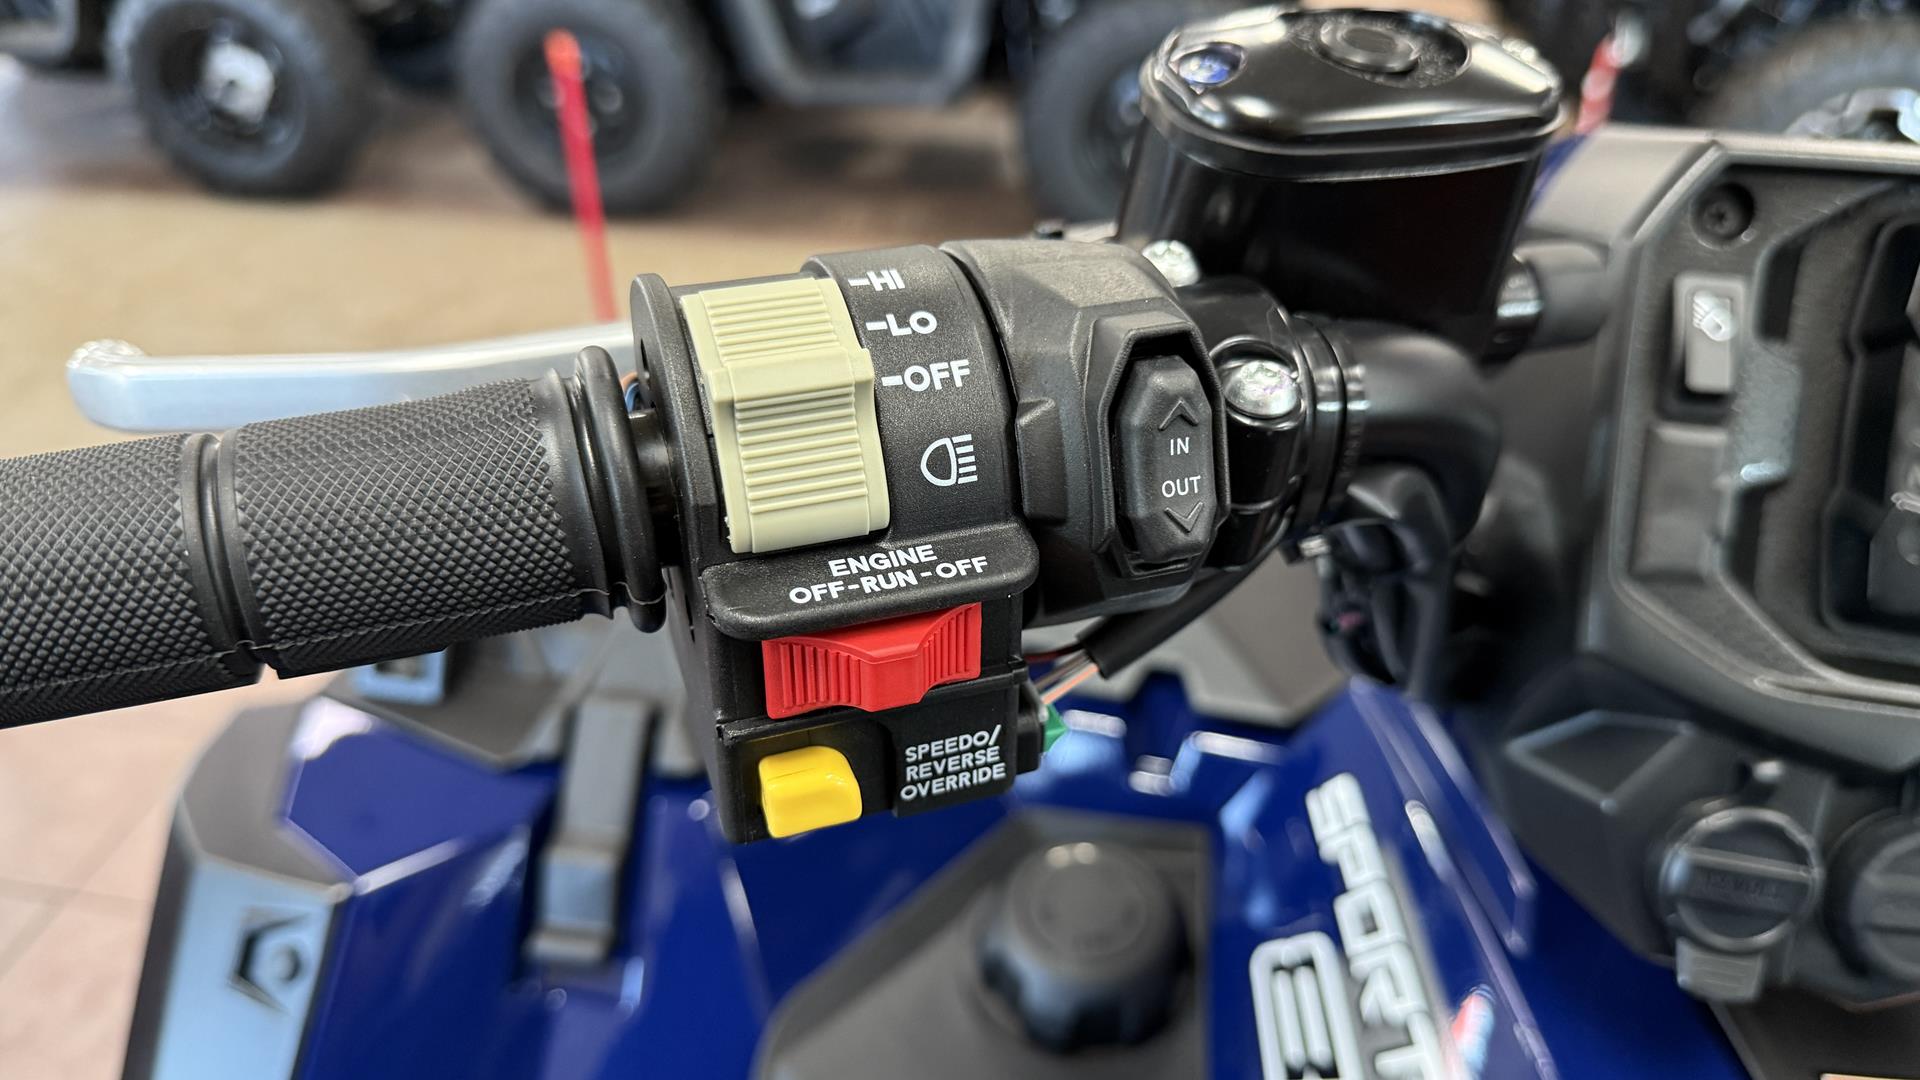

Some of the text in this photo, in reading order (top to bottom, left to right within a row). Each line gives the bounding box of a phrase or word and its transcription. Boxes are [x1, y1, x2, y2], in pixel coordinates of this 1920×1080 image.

[1169, 437, 1190, 456] IN
[1161, 475, 1202, 498] OUT
[828, 544, 938, 577] ENGINE
[905, 724, 1002, 763] SPEEDO/
[905, 746, 1000, 782] REVERSE
[900, 763, 1006, 800] OVERRIDE
